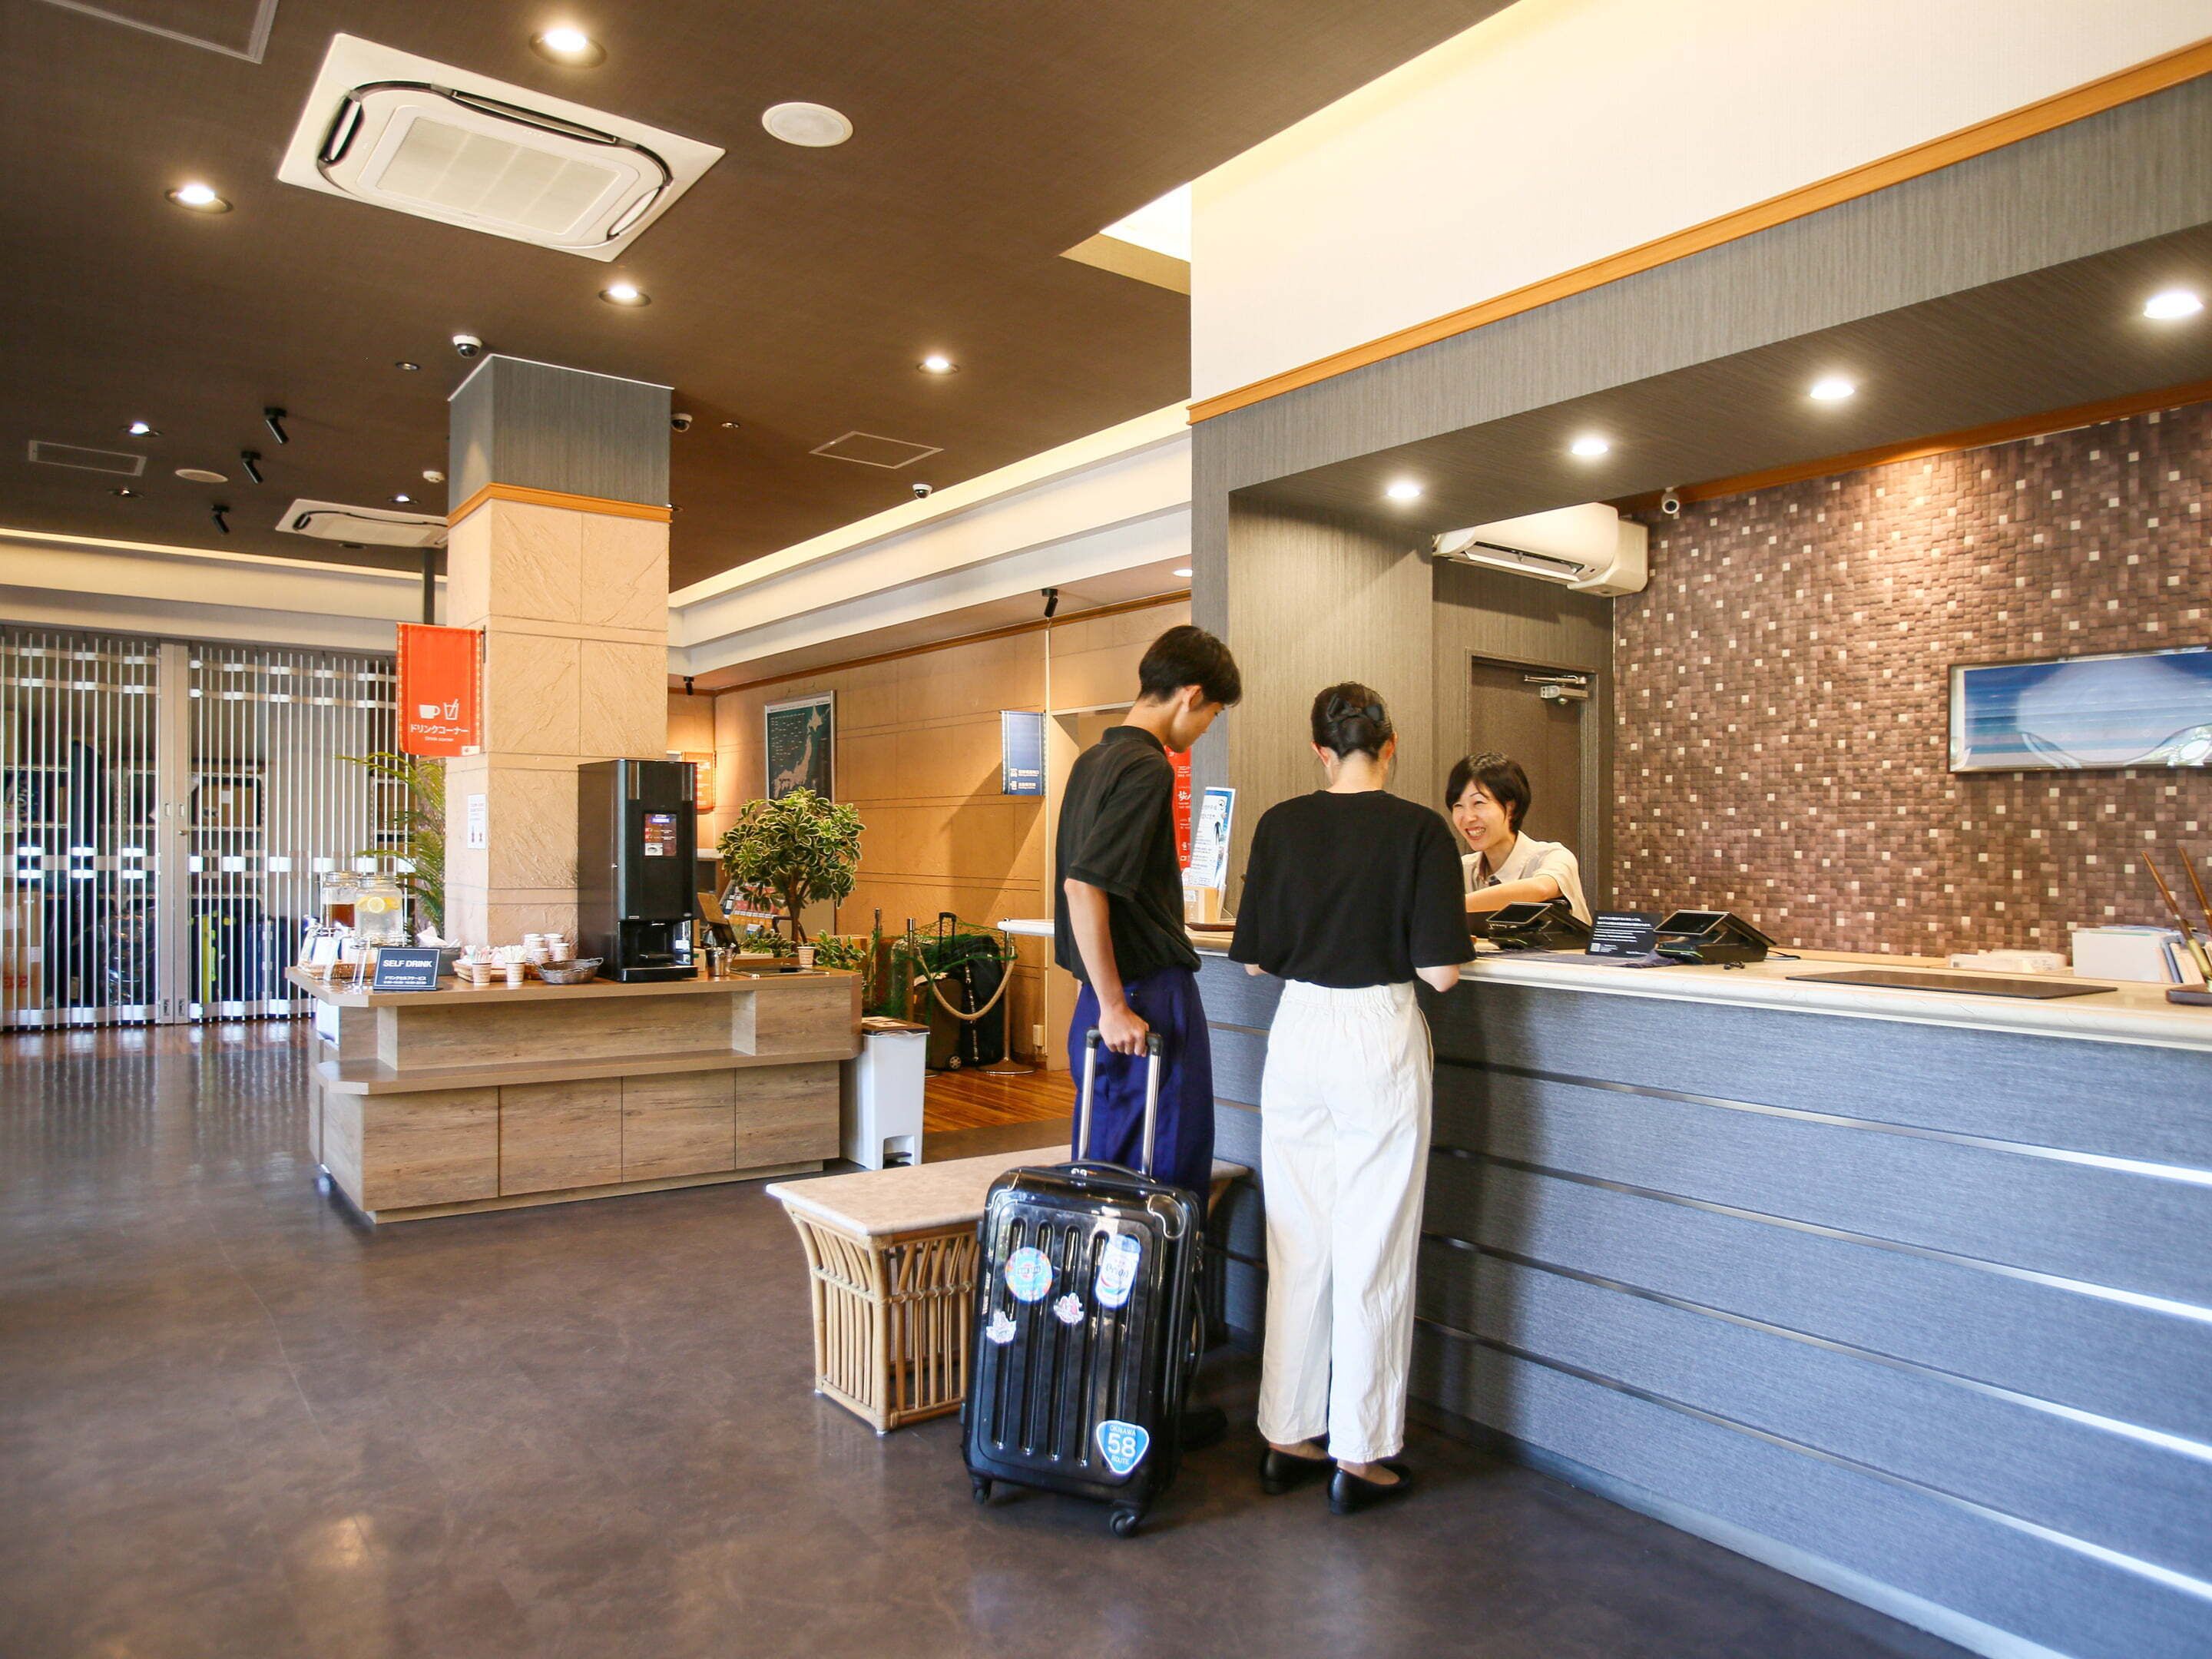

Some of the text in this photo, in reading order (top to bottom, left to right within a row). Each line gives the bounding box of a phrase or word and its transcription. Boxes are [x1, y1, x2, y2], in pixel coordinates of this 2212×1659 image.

[410, 724, 469, 735] ドリンクコーナー
[382, 959, 405, 968] SELF
[1110, 1425, 1136, 1436] OKINAWA
[1108, 1432, 1136, 1458] 58
[1111, 1455, 1131, 1465] ROUTE
